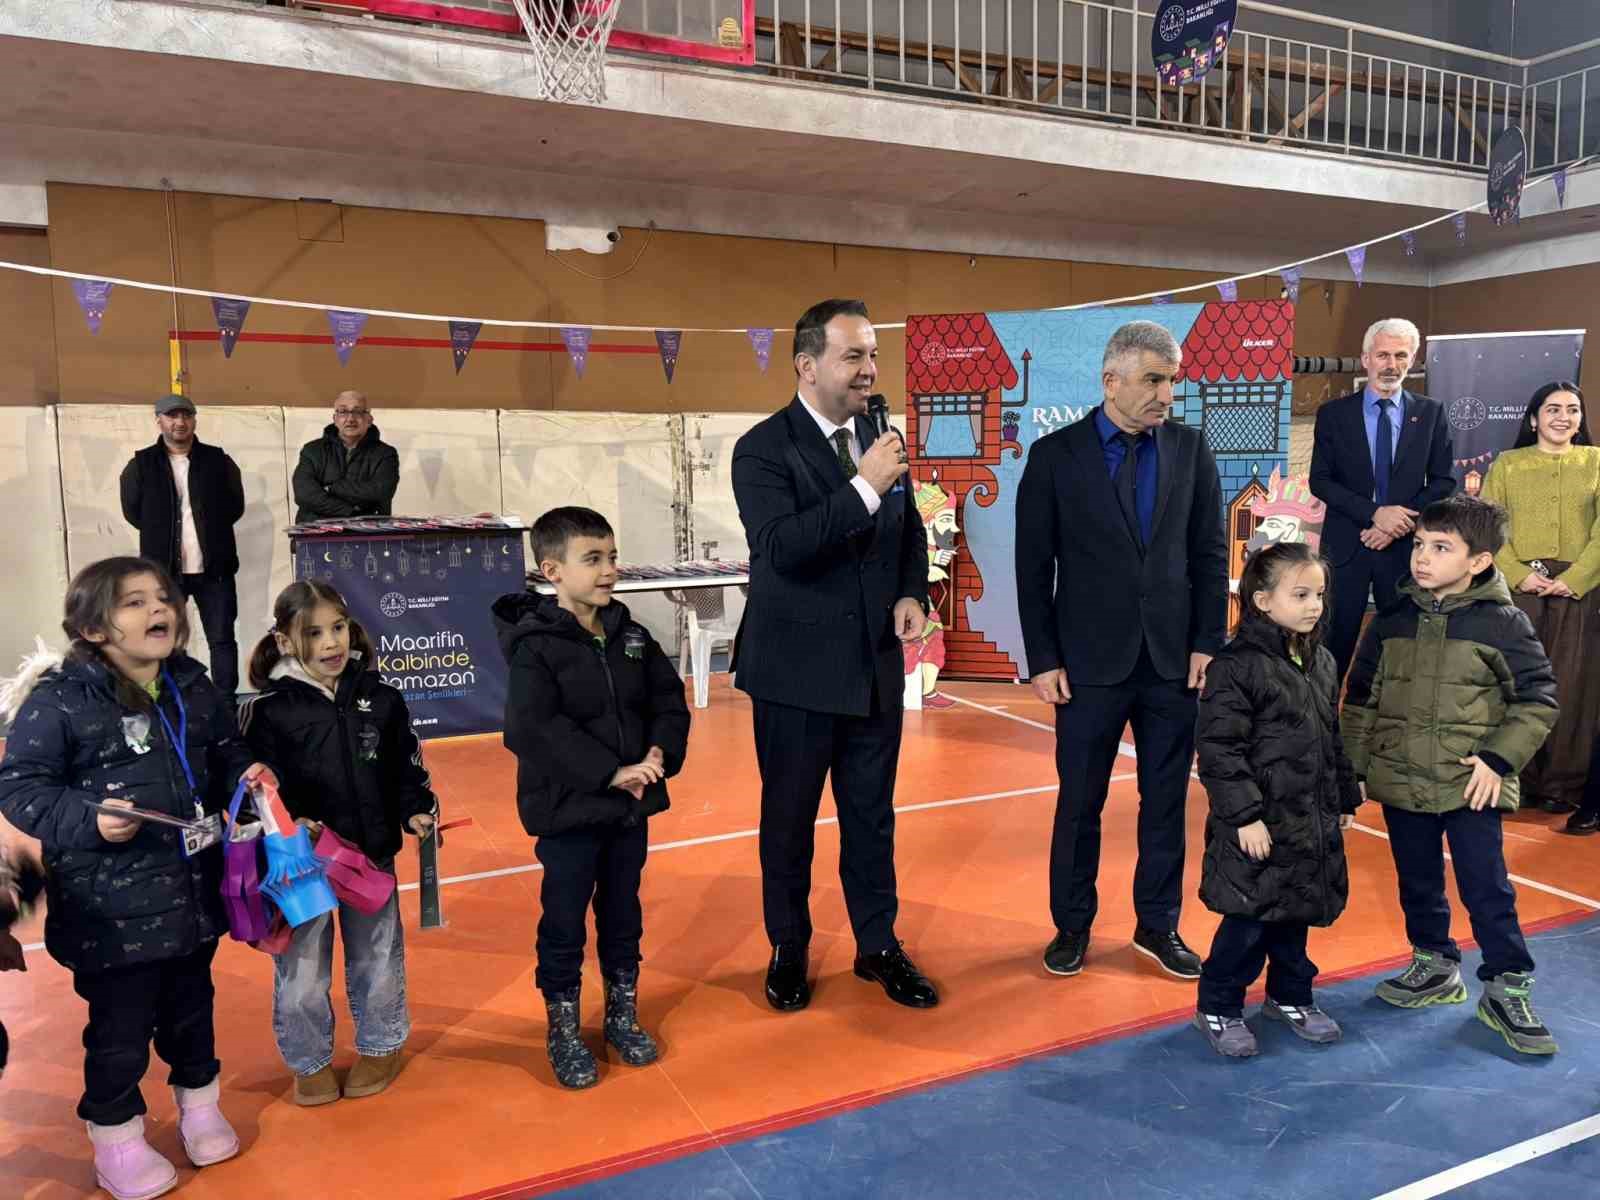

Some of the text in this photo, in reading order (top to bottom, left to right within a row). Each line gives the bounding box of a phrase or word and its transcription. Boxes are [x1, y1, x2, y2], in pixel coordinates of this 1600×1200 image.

[1032, 404, 1094, 425] RAM
[380, 631, 464, 652] Maarifin
[377, 650, 470, 673] Kalbinde
